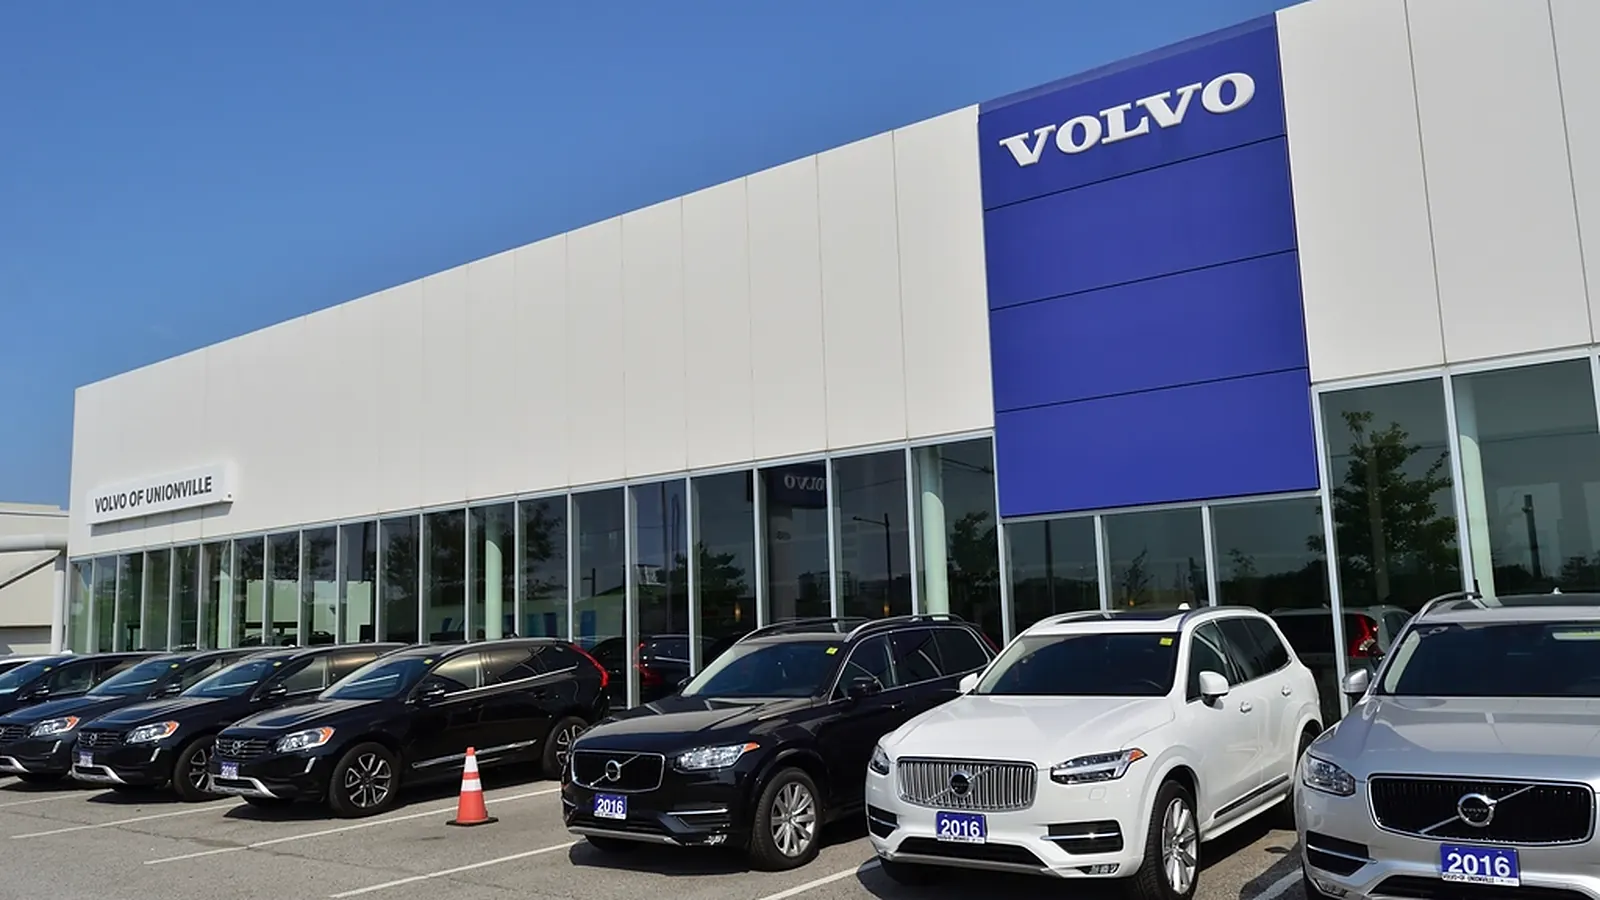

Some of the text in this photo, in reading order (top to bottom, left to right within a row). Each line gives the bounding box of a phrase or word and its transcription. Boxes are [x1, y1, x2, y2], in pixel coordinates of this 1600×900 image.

[999, 72, 1256, 167] VOLVO
[95, 476, 212, 513] VOLVO OF UNIONVILLE
[597, 798, 624, 814] 2016
[941, 819, 980, 838] 2016
[1447, 852, 1511, 877] 2016
